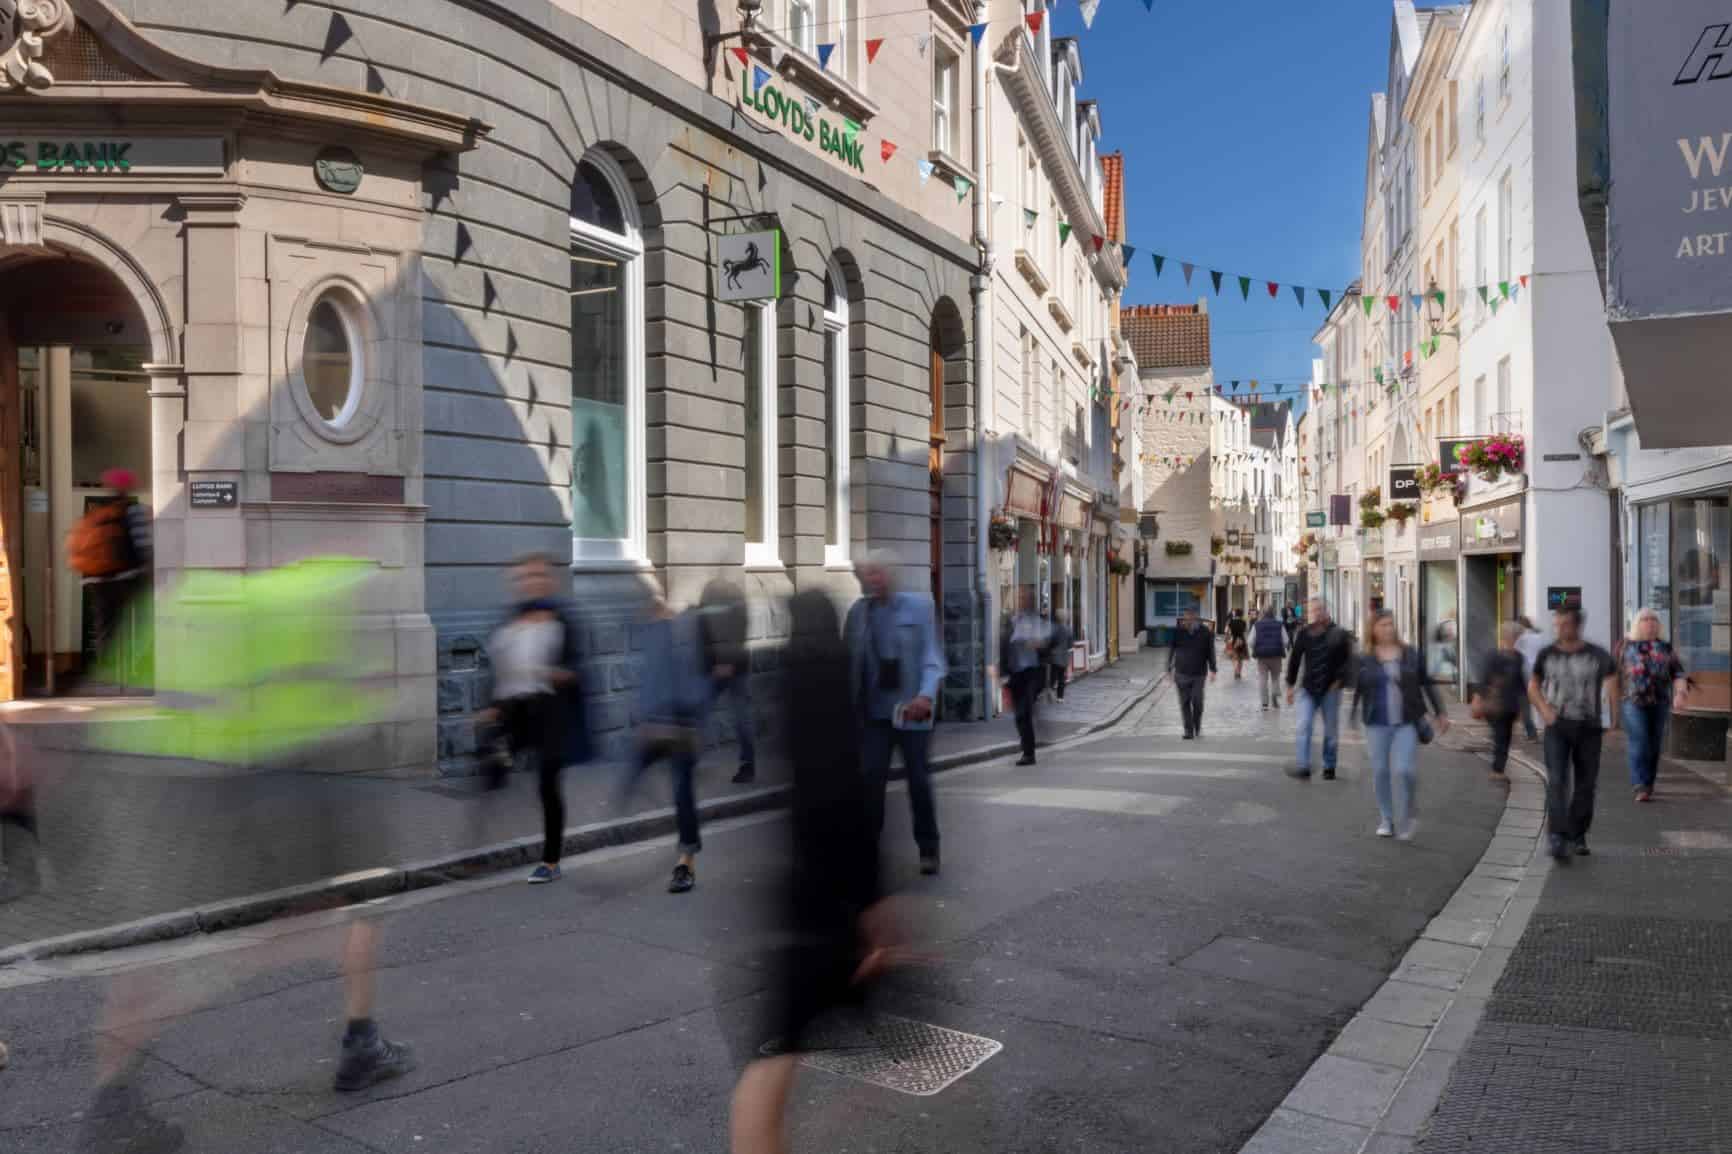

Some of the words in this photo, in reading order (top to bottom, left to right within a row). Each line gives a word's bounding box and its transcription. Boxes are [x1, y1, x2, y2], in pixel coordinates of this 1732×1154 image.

[742, 69, 815, 142] LLOYDS
[819, 118, 865, 174] BANK
[37, 141, 131, 168] BANK
[1675, 231, 1728, 258] ART
